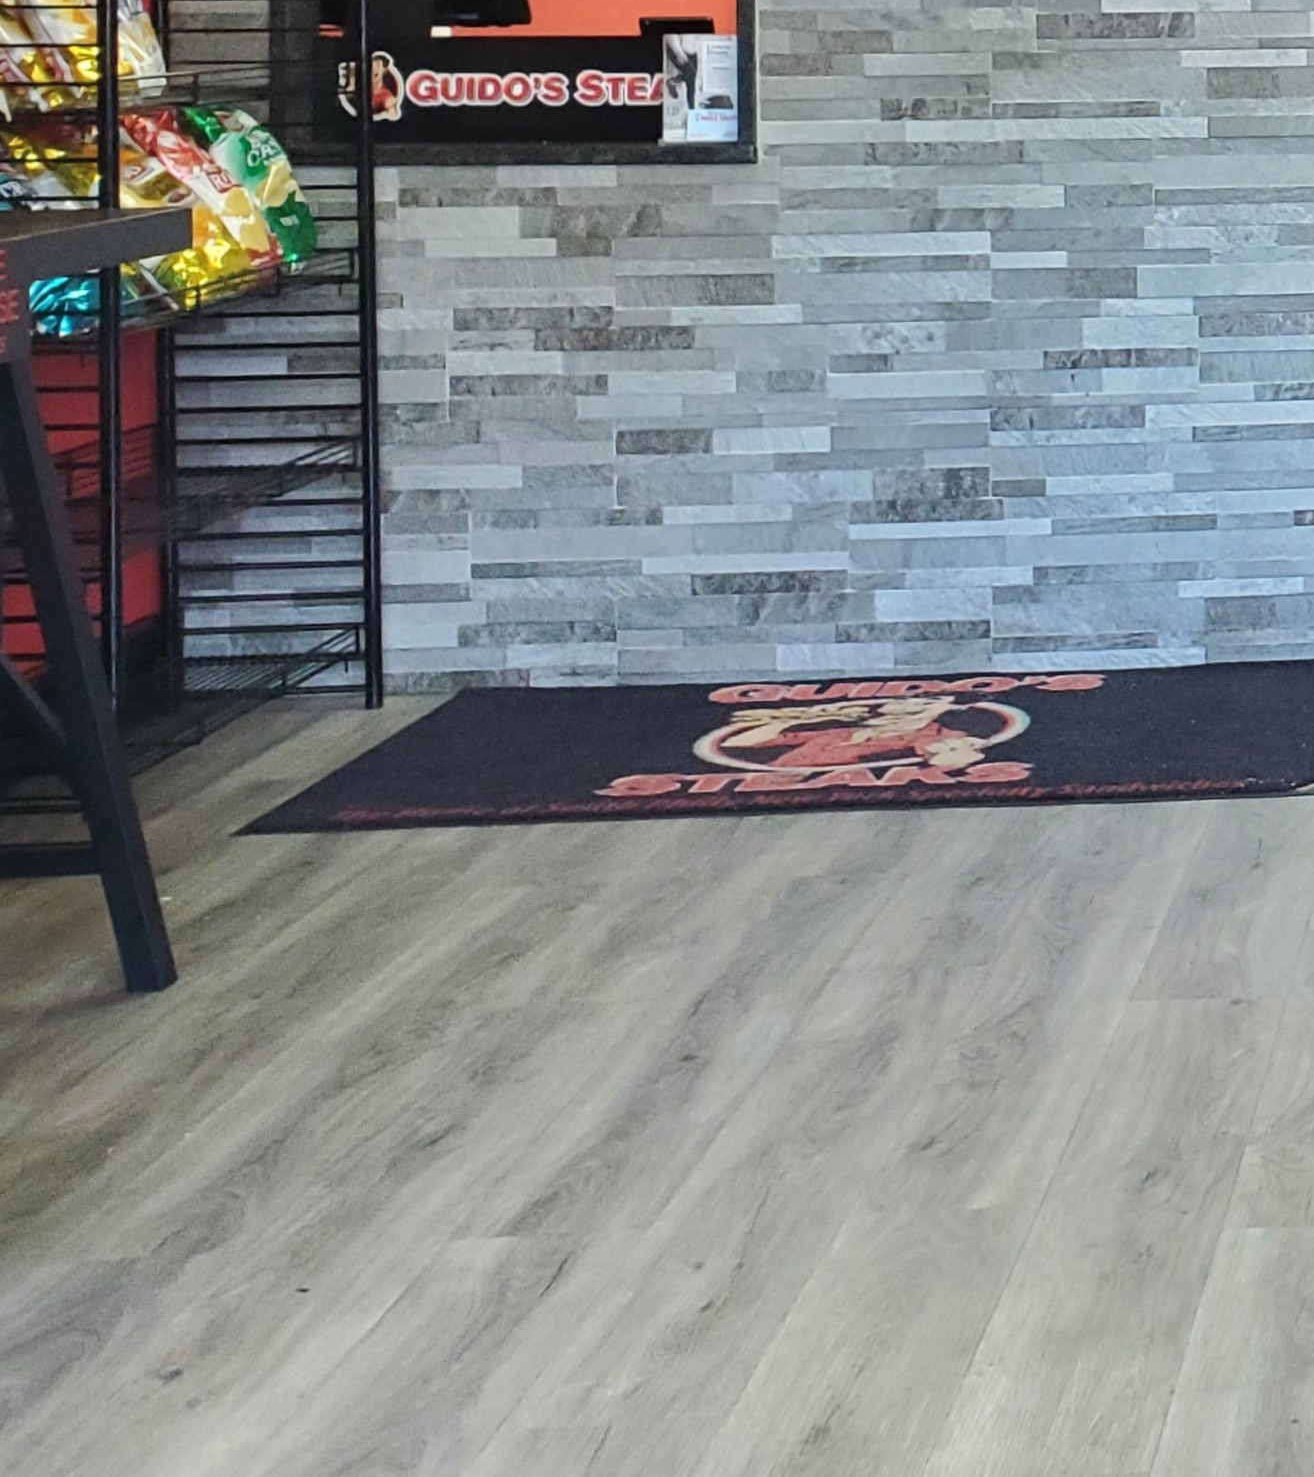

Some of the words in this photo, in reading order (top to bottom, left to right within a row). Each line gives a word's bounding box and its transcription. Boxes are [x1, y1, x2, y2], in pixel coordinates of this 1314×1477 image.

[406, 70, 568, 107] GUIDO'S
[709, 673, 1107, 704] GUIDO'S
[595, 762, 1035, 797] STEAKS
